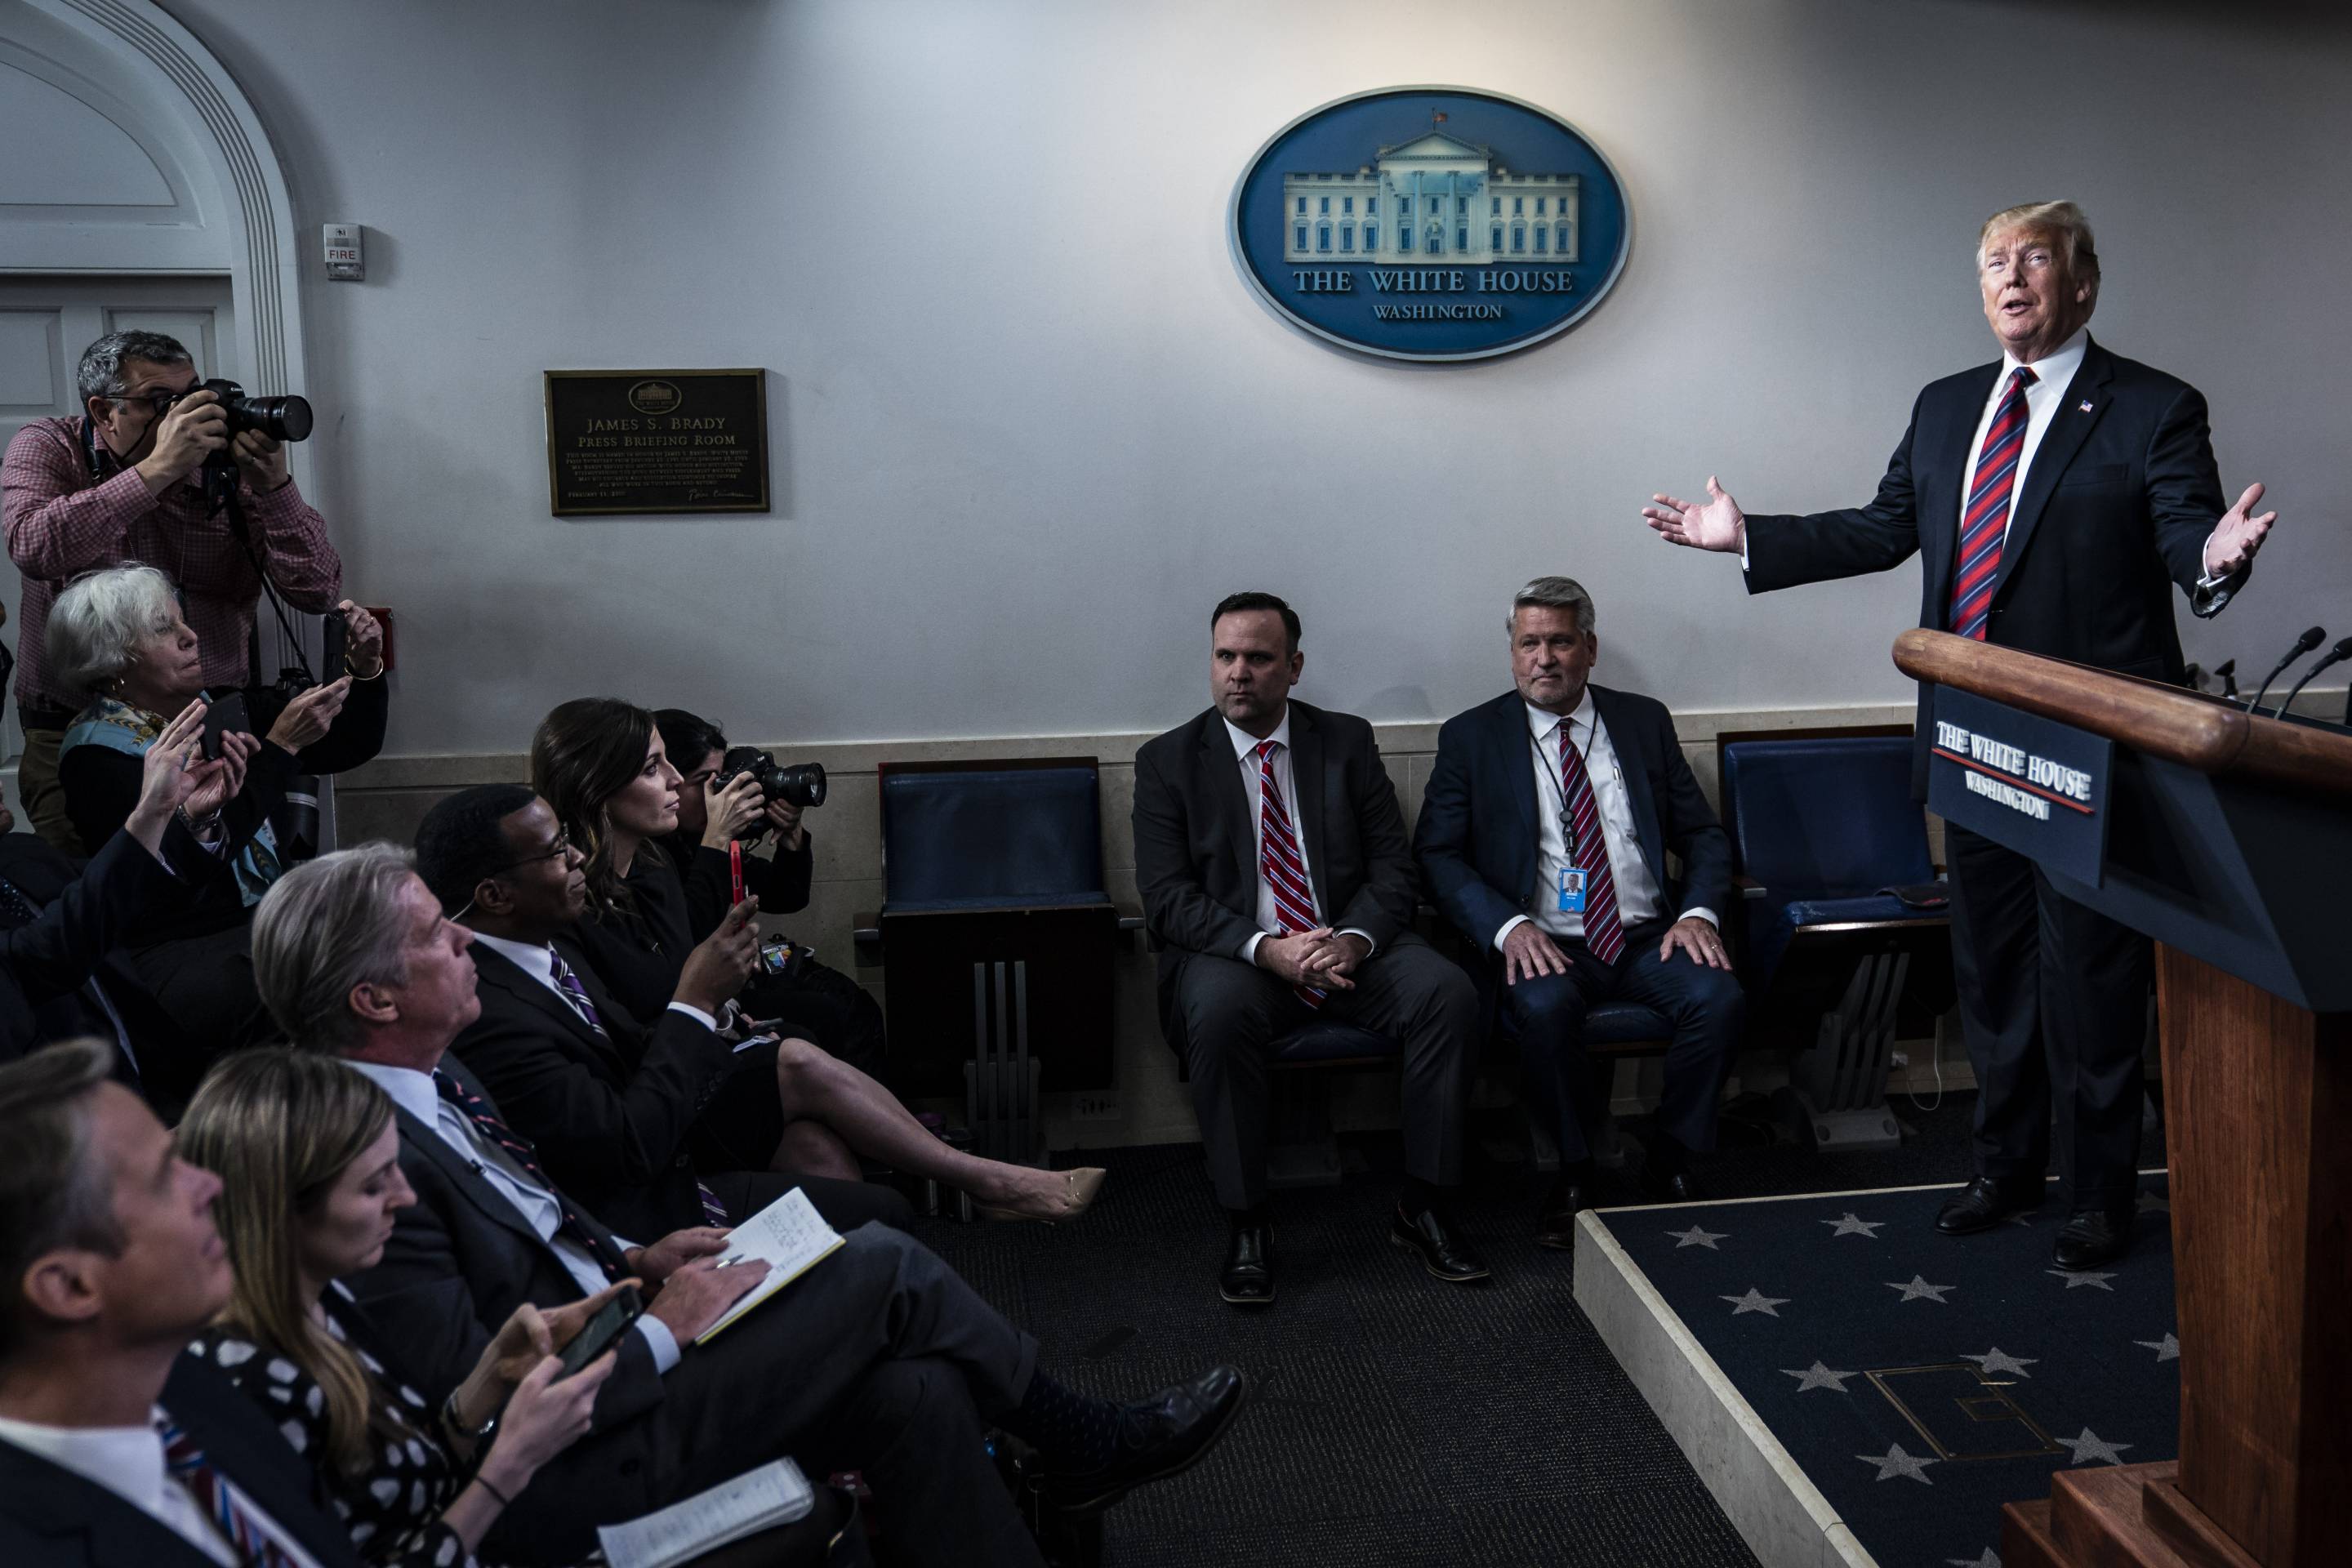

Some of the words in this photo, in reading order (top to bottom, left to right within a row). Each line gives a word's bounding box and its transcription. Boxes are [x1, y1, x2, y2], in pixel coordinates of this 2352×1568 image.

[330, 250, 355, 259] FIRE
[1293, 271, 1352, 292] THE
[1368, 271, 1465, 292] WHITE
[1477, 271, 1573, 292] HOUSE
[1372, 305, 1503, 319] WASHINGTON
[587, 419, 639, 433] JAMES
[647, 418, 662, 430] S.
[671, 417, 725, 430] BRADY
[578, 437, 617, 448] PRESS
[624, 435, 688, 447] BRIEFING
[695, 434, 736, 445] ROOM
[1937, 720, 1970, 754] THE
[1970, 733, 2026, 776] WHITE
[2028, 755, 2092, 801] HOUSE
[1965, 770, 2051, 820] WASHINGTON
